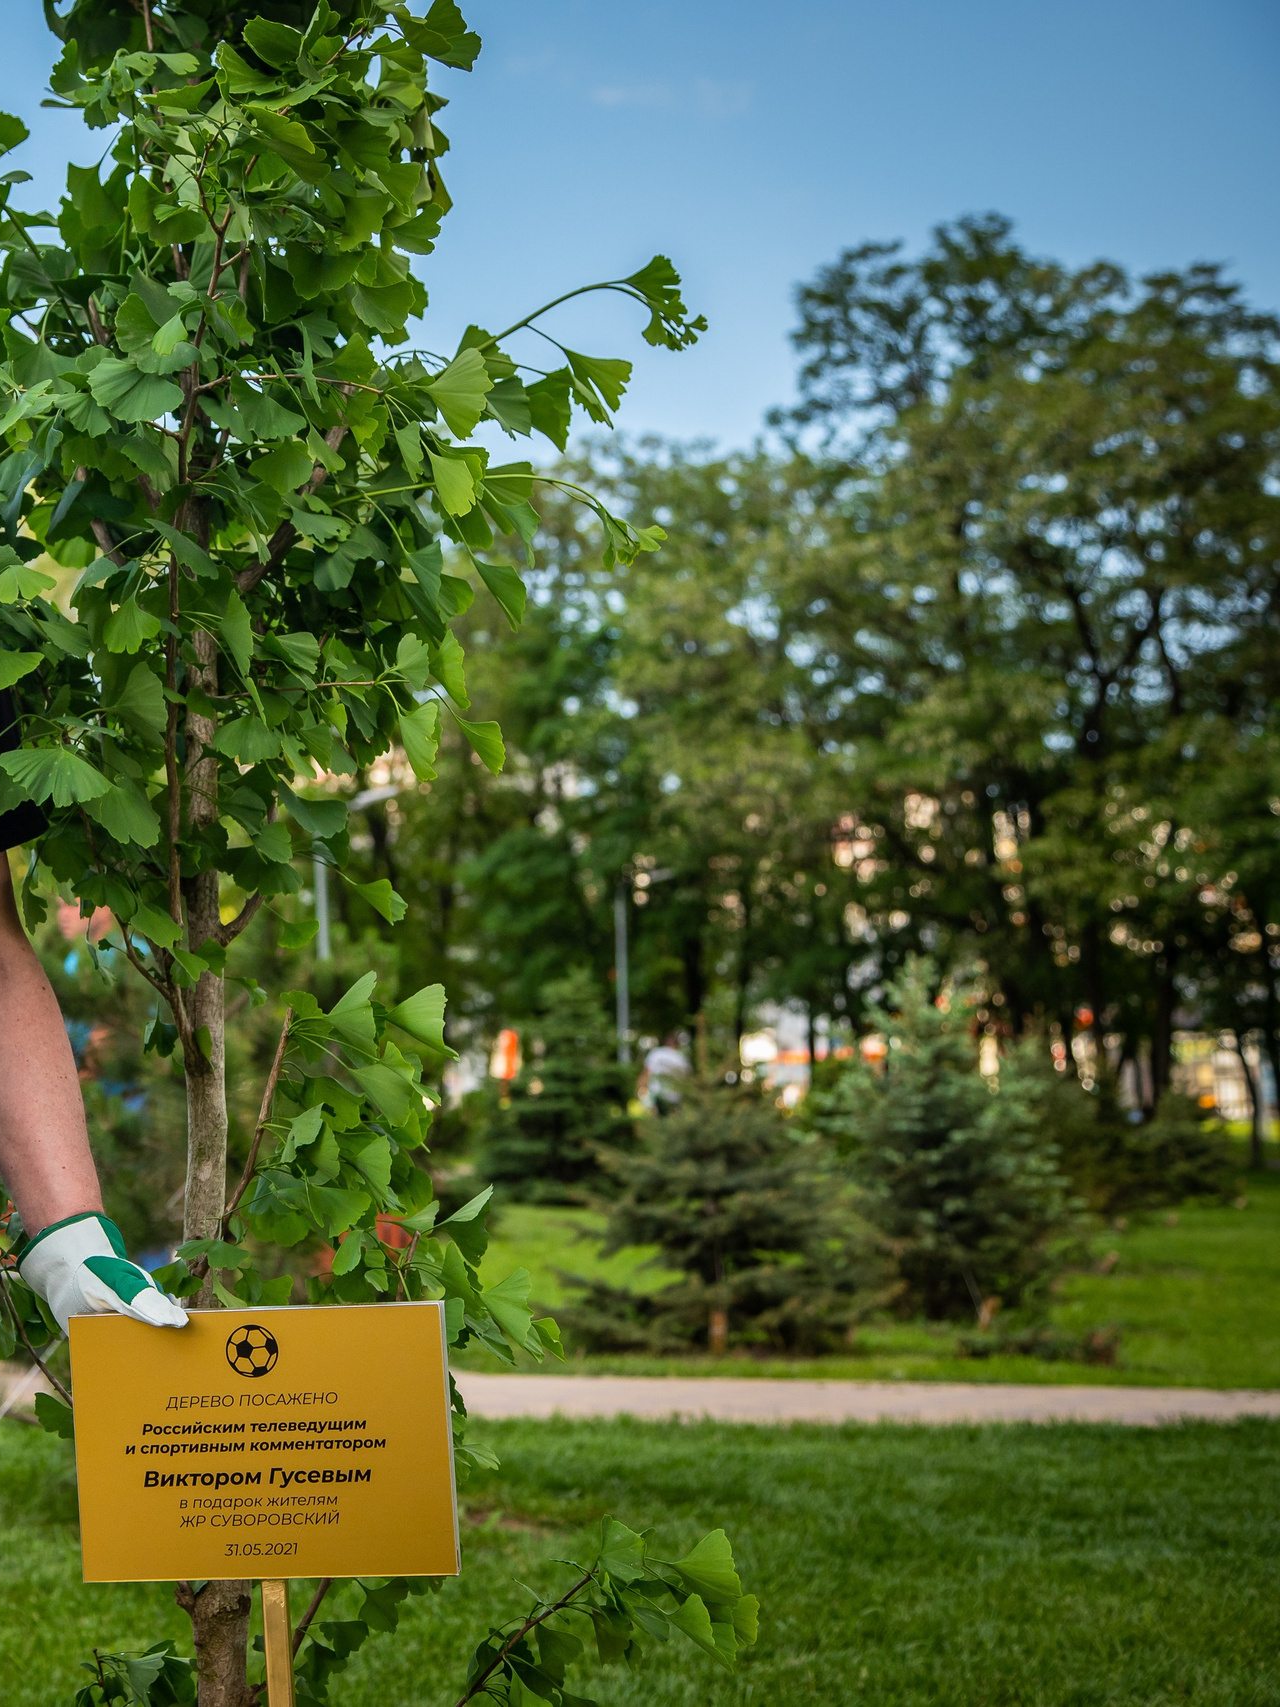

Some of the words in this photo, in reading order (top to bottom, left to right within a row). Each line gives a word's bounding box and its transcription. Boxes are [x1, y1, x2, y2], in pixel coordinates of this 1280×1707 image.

[166, 1394, 234, 1411] ДЕРЕВО
[239, 1391, 338, 1407] ПОСАЖЕНО
[142, 1421, 245, 1436] Российским
[250, 1418, 366, 1433] телеведущим
[125, 1445, 136, 1456] и
[140, 1441, 245, 1456] спортивным
[250, 1437, 387, 1453] комментатором
[143, 1470, 261, 1490] Виктором
[269, 1467, 371, 1488] Гусевым
[179, 1500, 188, 1509] в
[192, 1497, 263, 1510] подарок
[267, 1495, 338, 1507] жителям
[179, 1515, 206, 1528] ЖР
[210, 1509, 340, 1527] СУВОРОВСКИЙ
[224, 1542, 298, 1557] 31.05.2021
